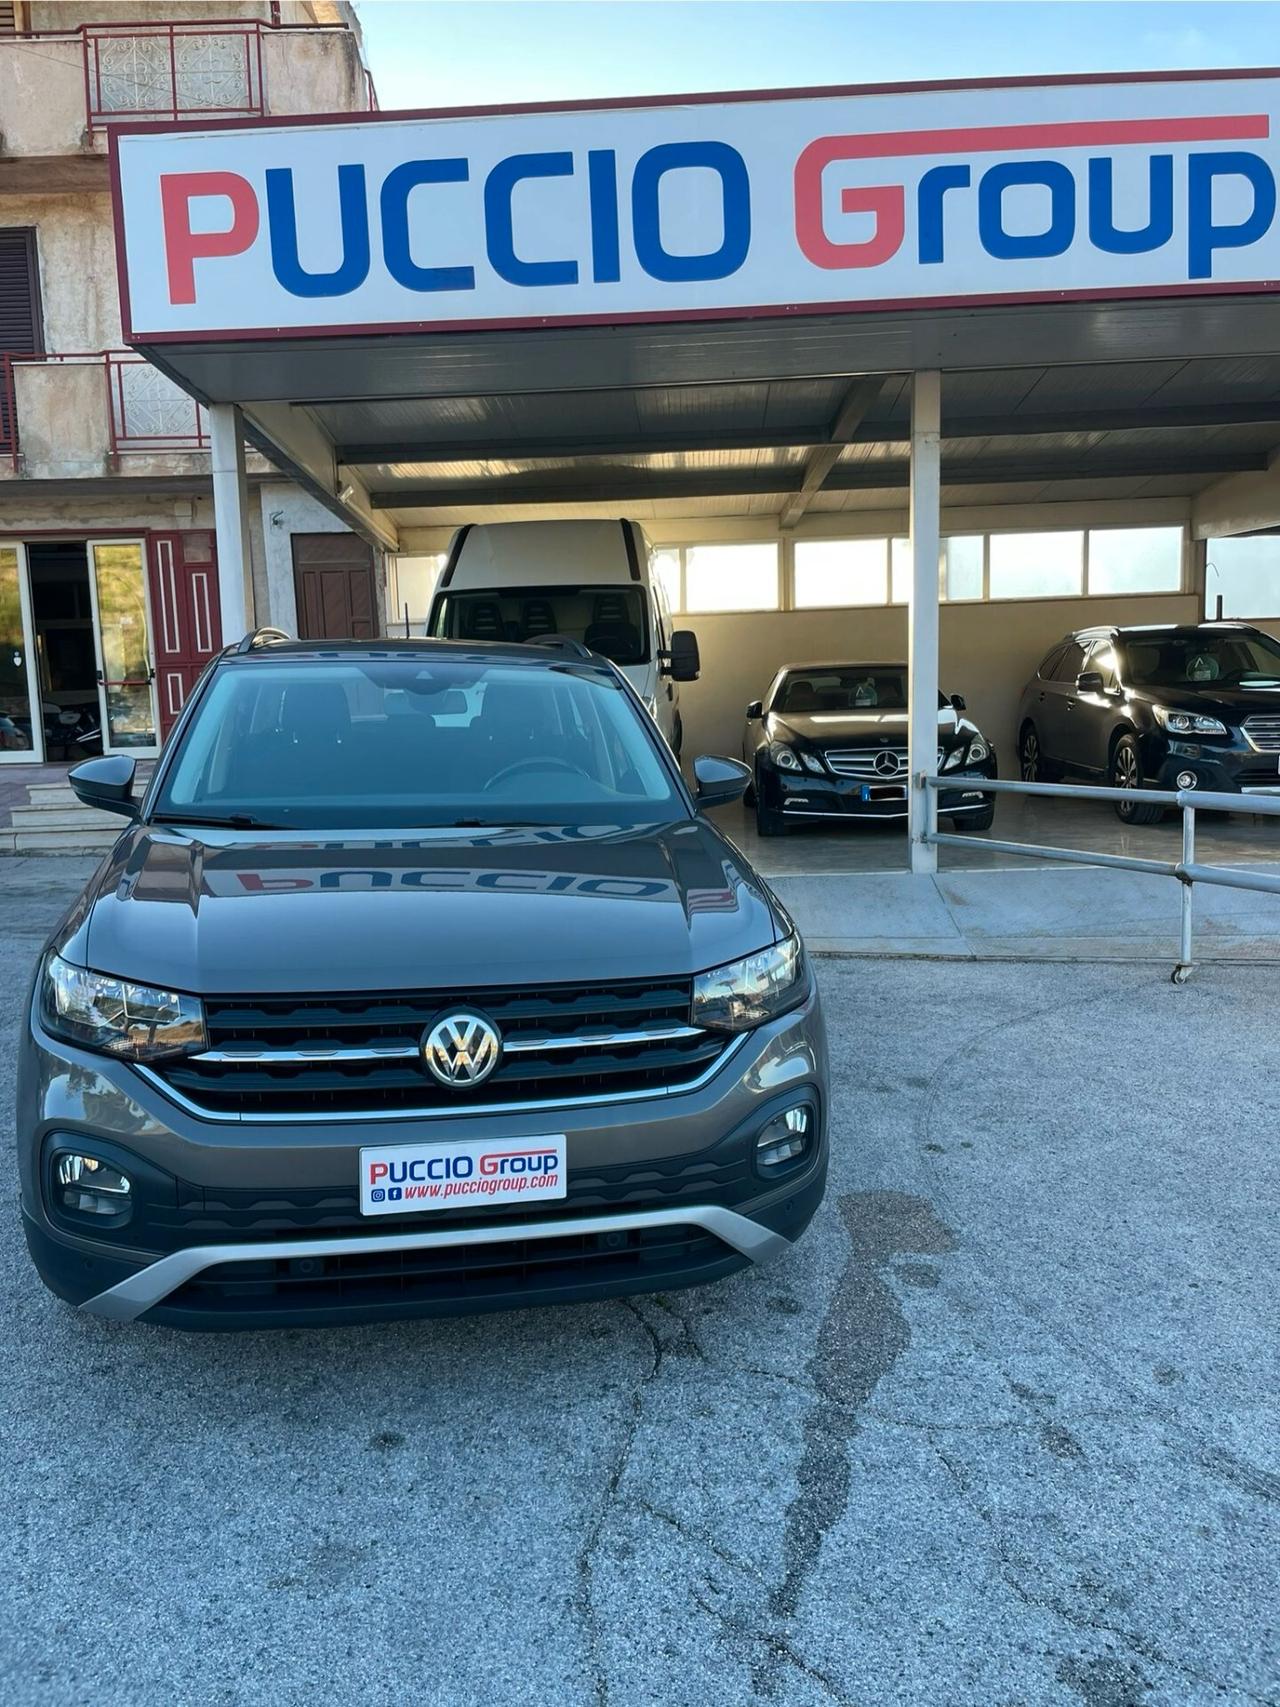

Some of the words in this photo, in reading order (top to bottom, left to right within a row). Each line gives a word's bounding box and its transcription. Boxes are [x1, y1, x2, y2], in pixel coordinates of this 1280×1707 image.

[160, 140, 752, 304] PUCCIO
[793, 115, 1278, 280] Group
[424, 1014, 499, 1087] VW
[370, 1156, 473, 1184] PUCCIO
[479, 1149, 559, 1175] Group
[404, 1174, 559, 1200] www.pucciogroup.com
